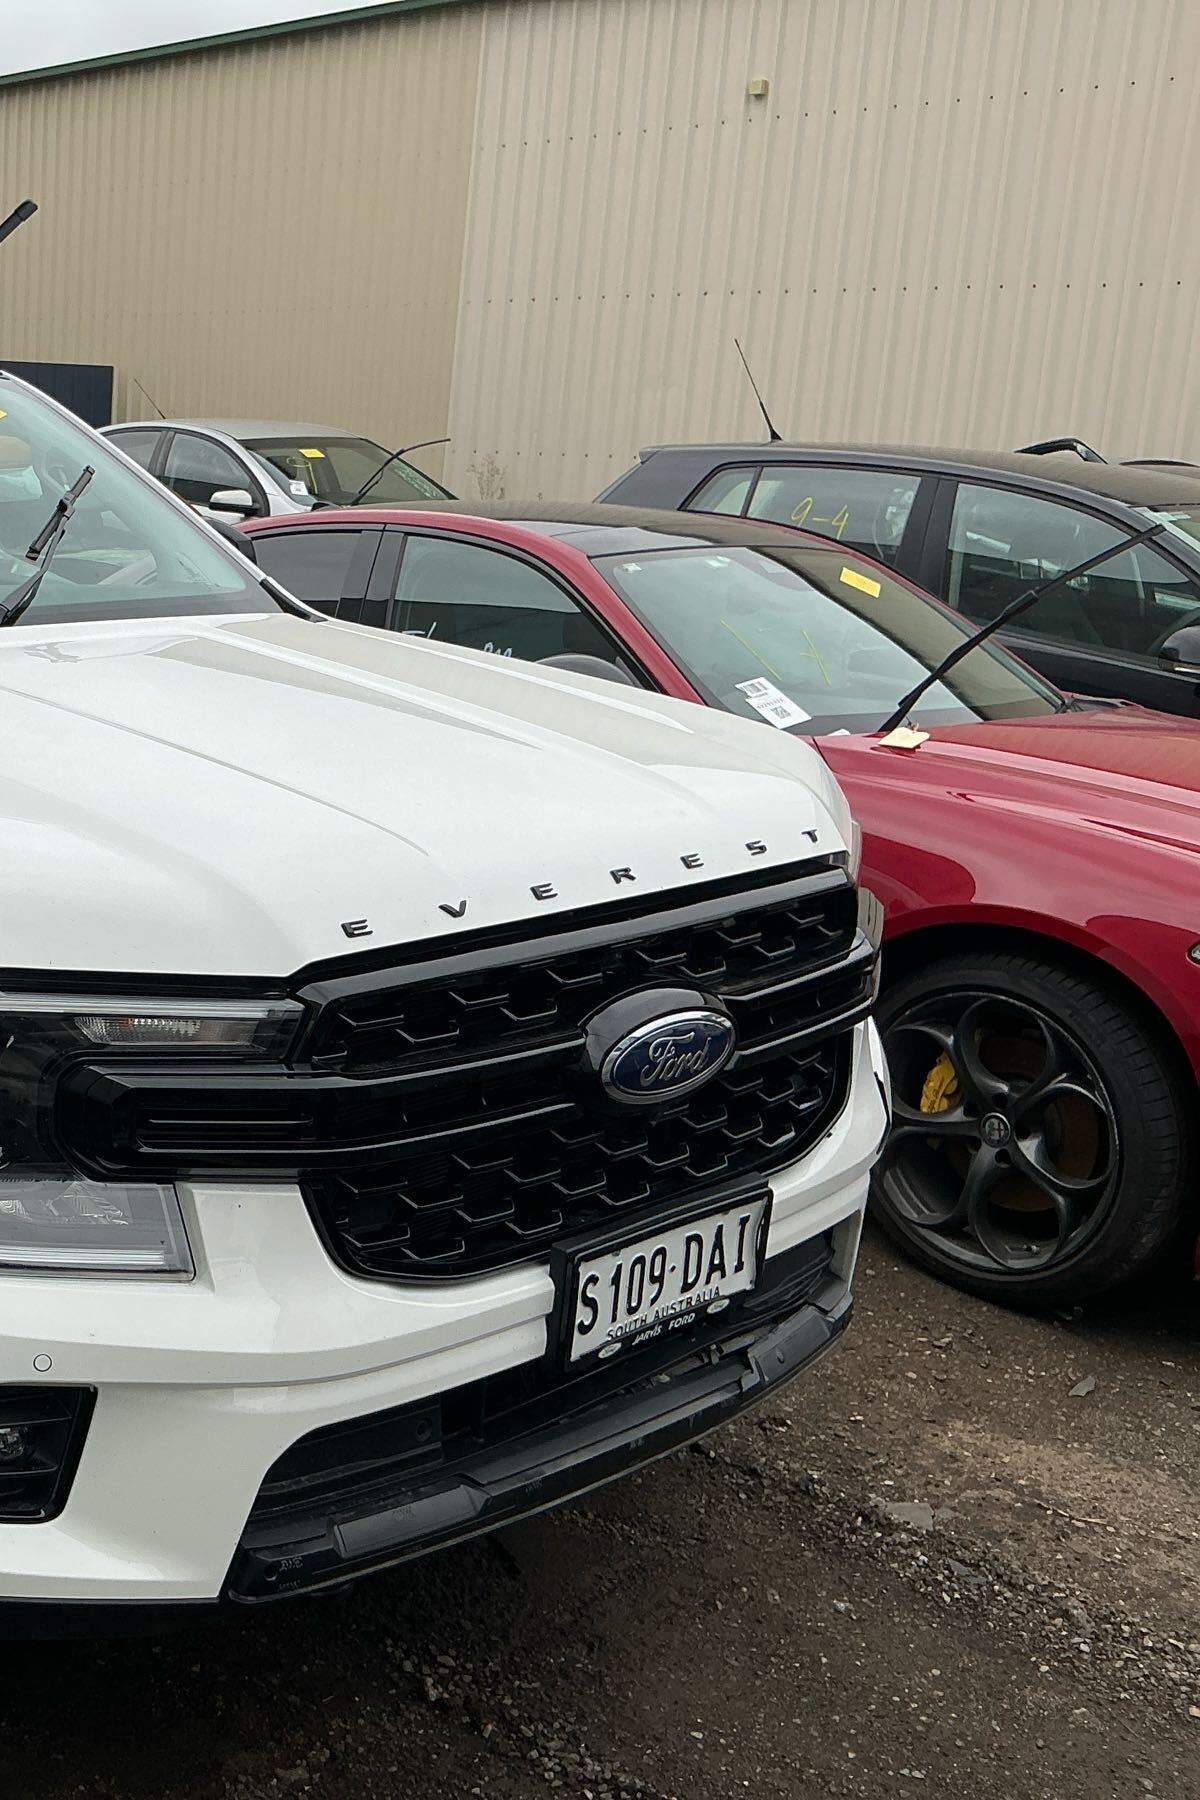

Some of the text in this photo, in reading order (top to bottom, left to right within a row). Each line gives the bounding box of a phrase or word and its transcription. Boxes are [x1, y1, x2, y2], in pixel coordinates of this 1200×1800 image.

[340, 827, 820, 939] EVEREST
[639, 1031, 712, 1087] Ford
[606, 1313, 648, 1341] SOUTH
[653, 1285, 721, 1323] AUSTRALIA
[667, 1312, 696, 1332] FORD
